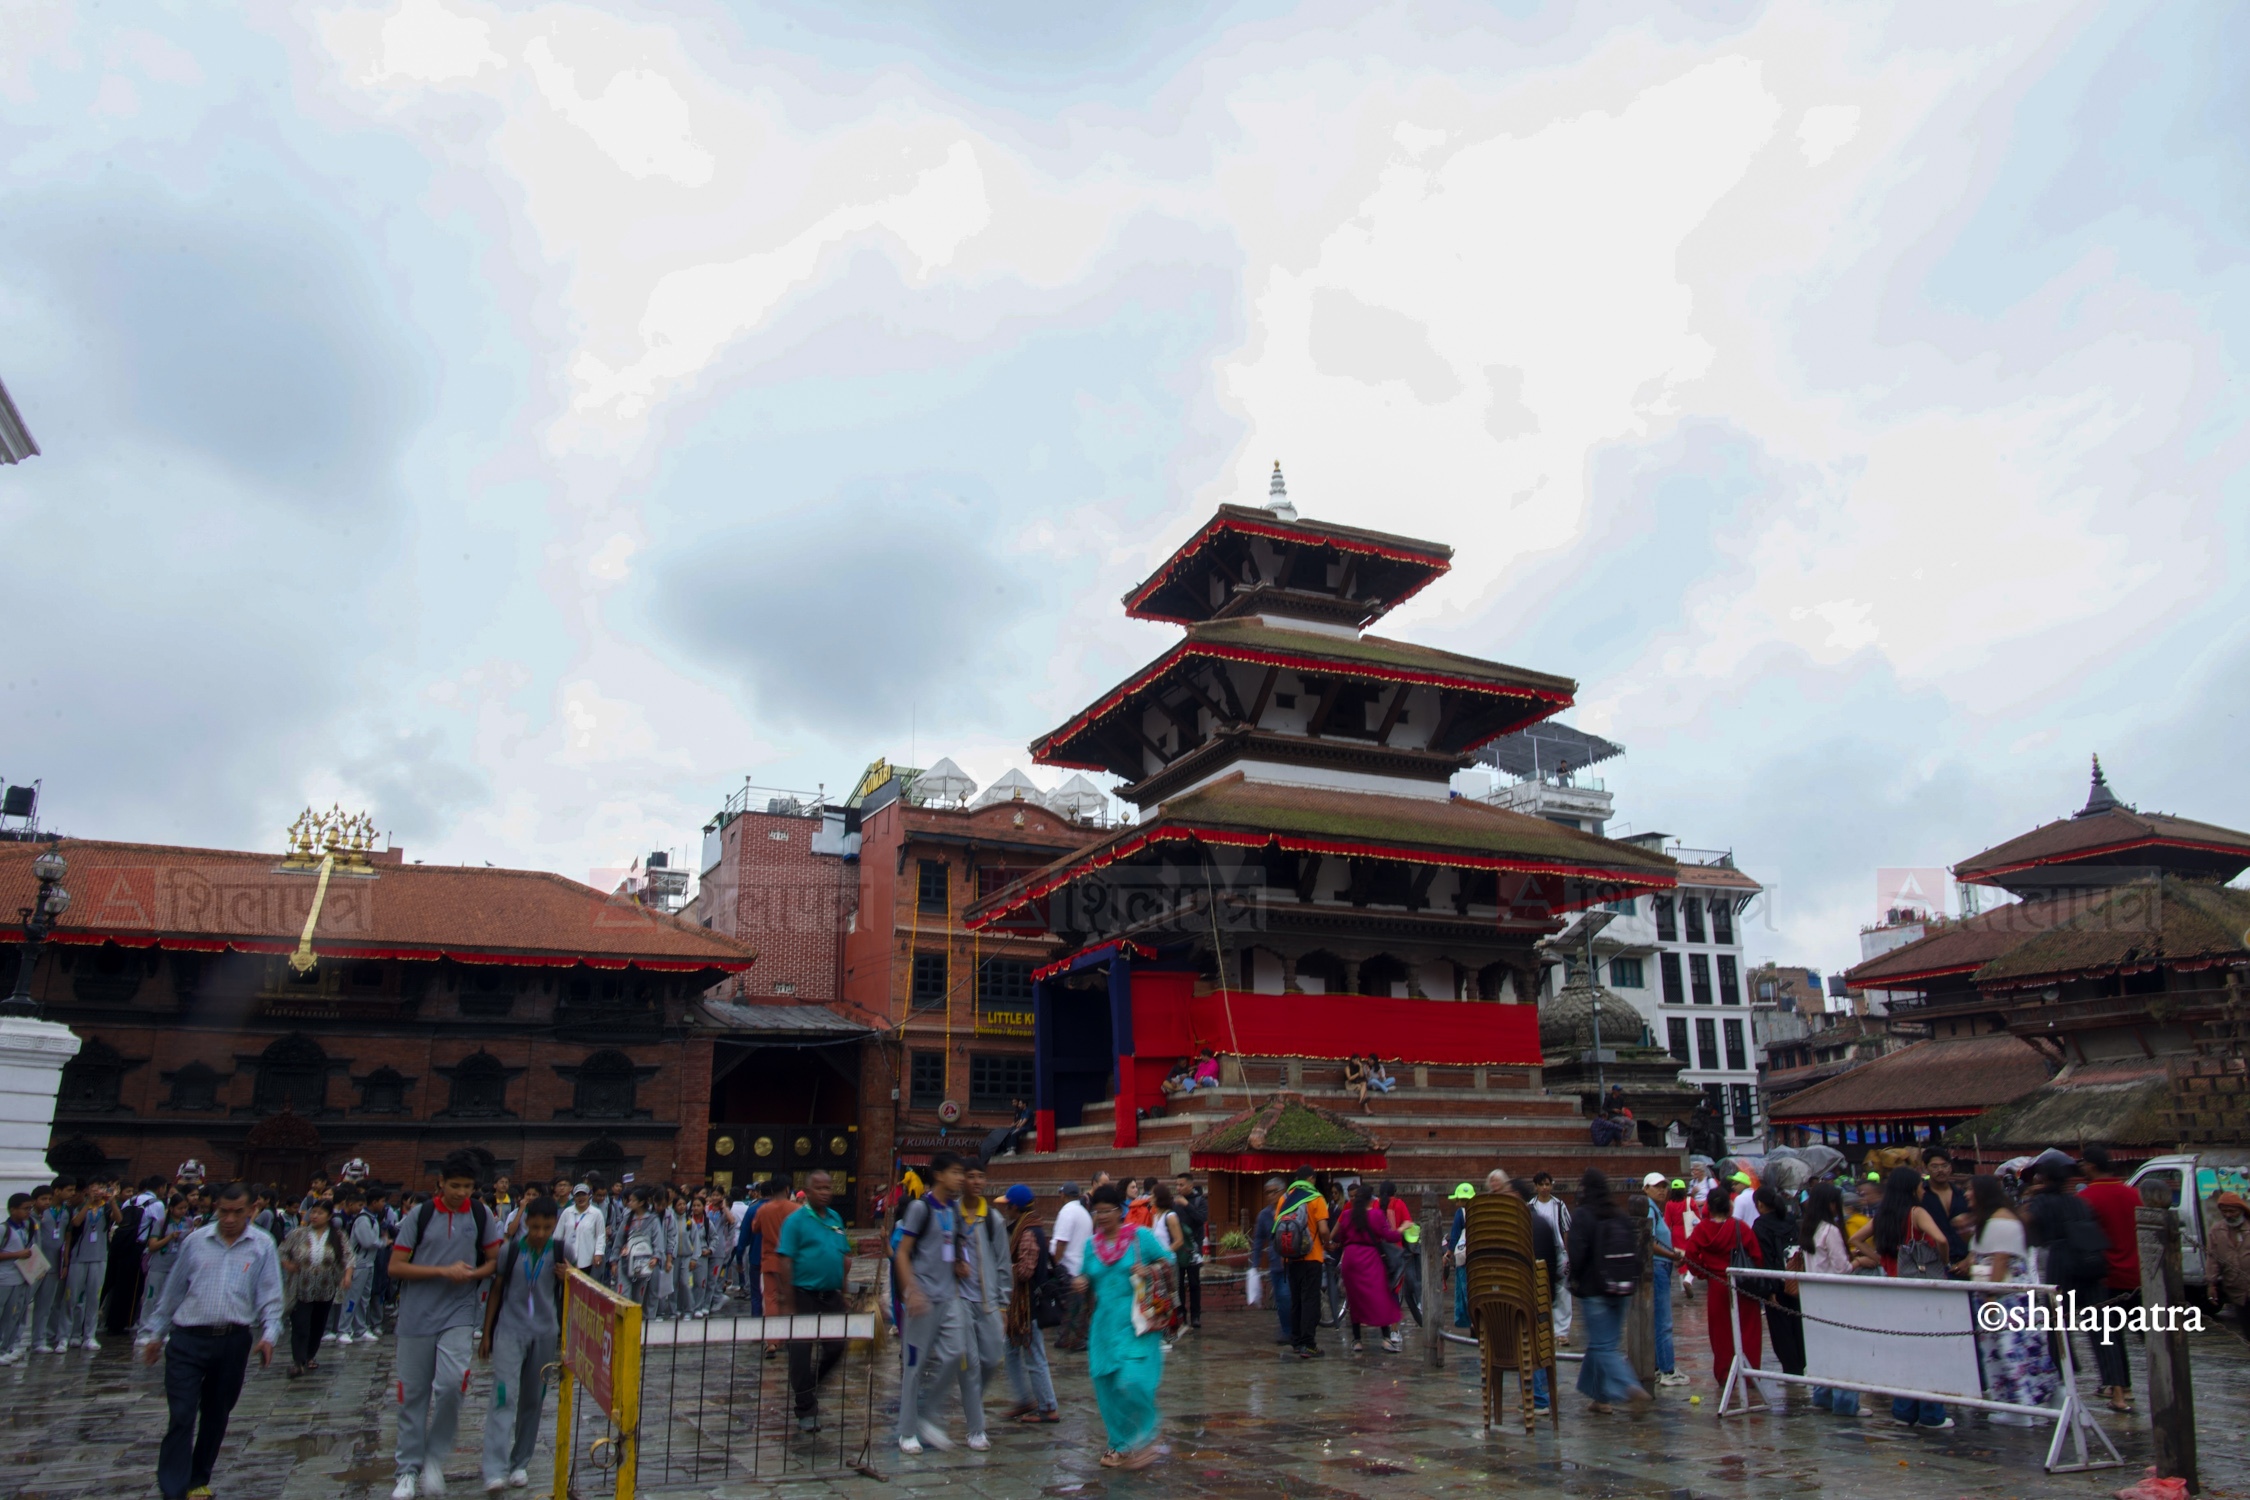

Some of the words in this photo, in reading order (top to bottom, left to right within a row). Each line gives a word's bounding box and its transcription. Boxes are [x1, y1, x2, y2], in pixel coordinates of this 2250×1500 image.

[862, 764, 893, 799] KUMARI
[987, 1011, 1022, 1025] LITTLE
[974, 1025, 1003, 1035] Chinese
[1006, 1027, 1032, 1037] Korean
[906, 1137, 946, 1147] KUMARI
[947, 1138, 983, 1148] BAKER
